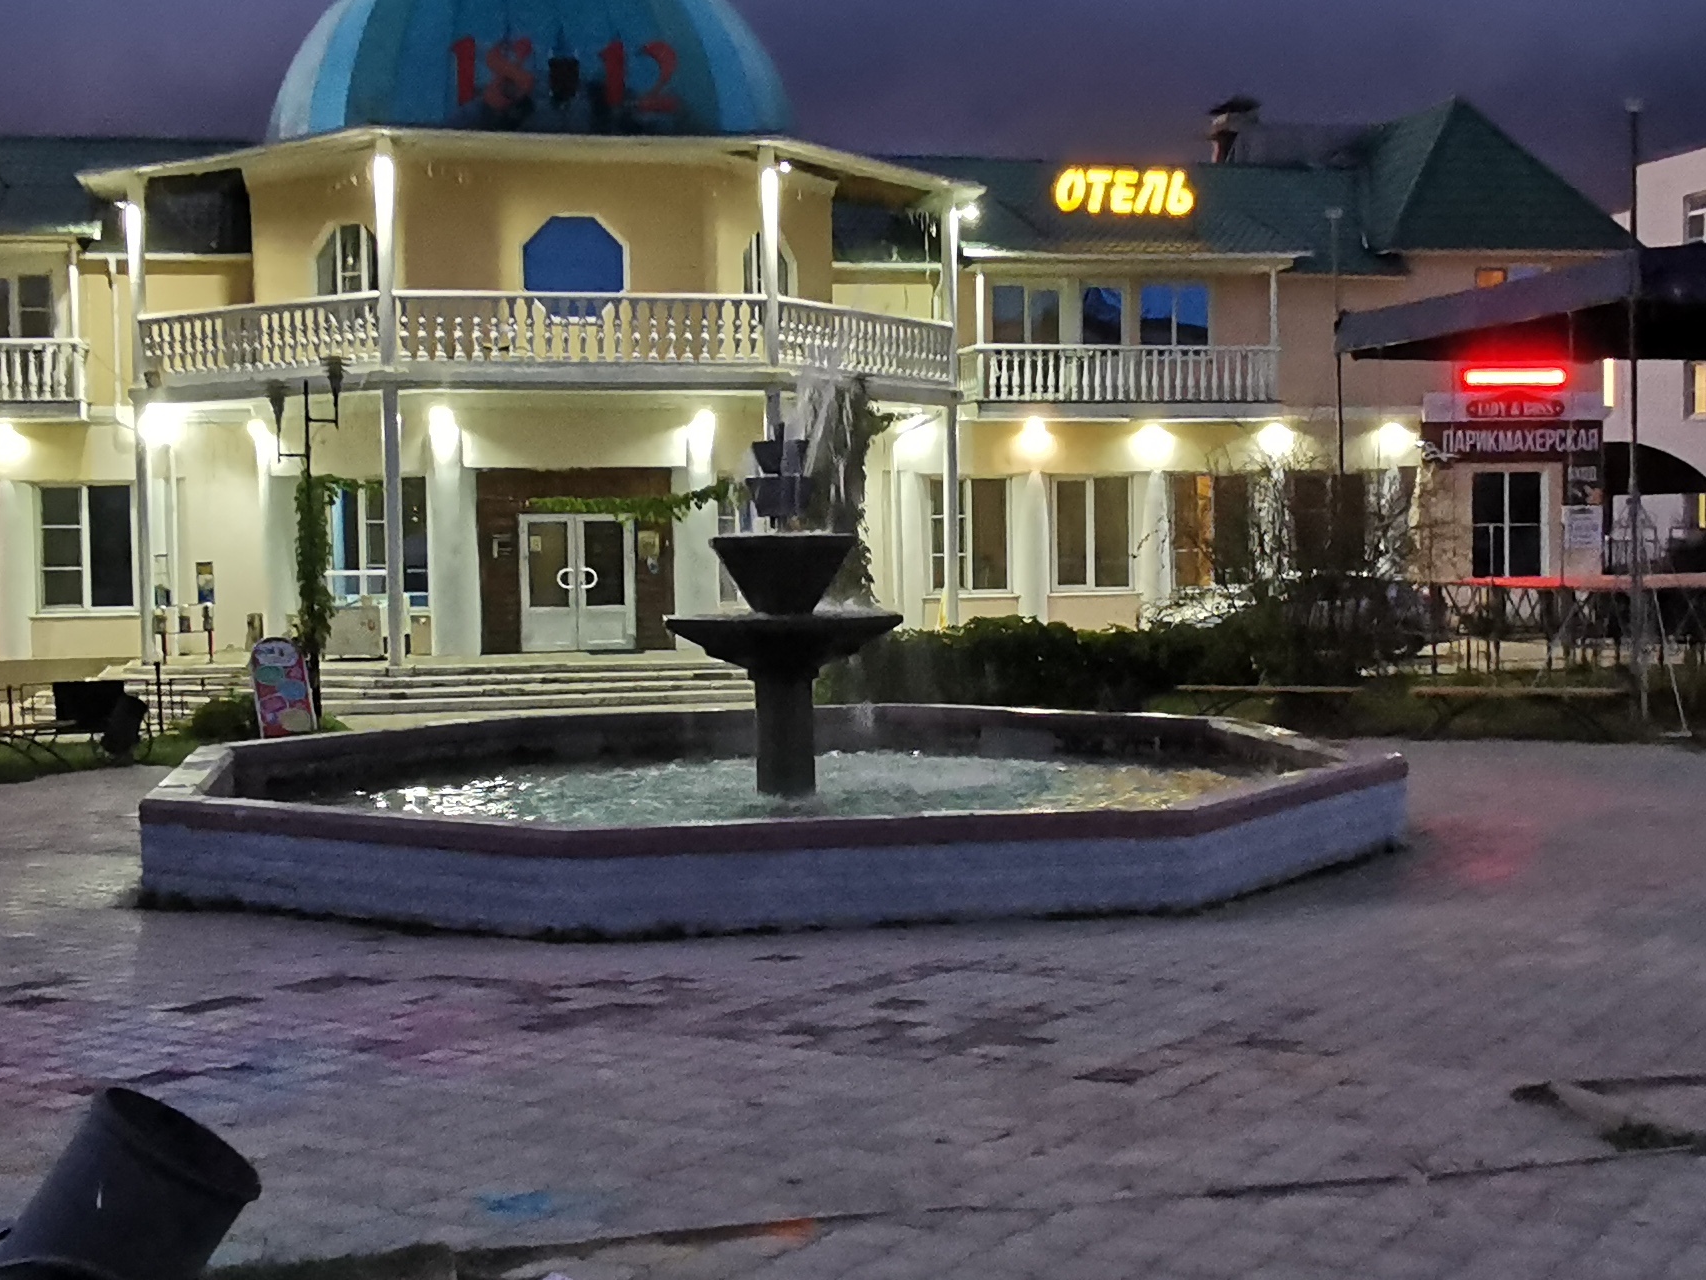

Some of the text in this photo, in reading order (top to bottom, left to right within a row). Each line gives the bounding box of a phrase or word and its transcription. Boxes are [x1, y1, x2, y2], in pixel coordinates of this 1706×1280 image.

[598, 39, 679, 112] 12
[1054, 166, 1195, 216] ОТЕЛЬ
[1442, 427, 1599, 453] ПАРИКМАХЕРСКАЯ
